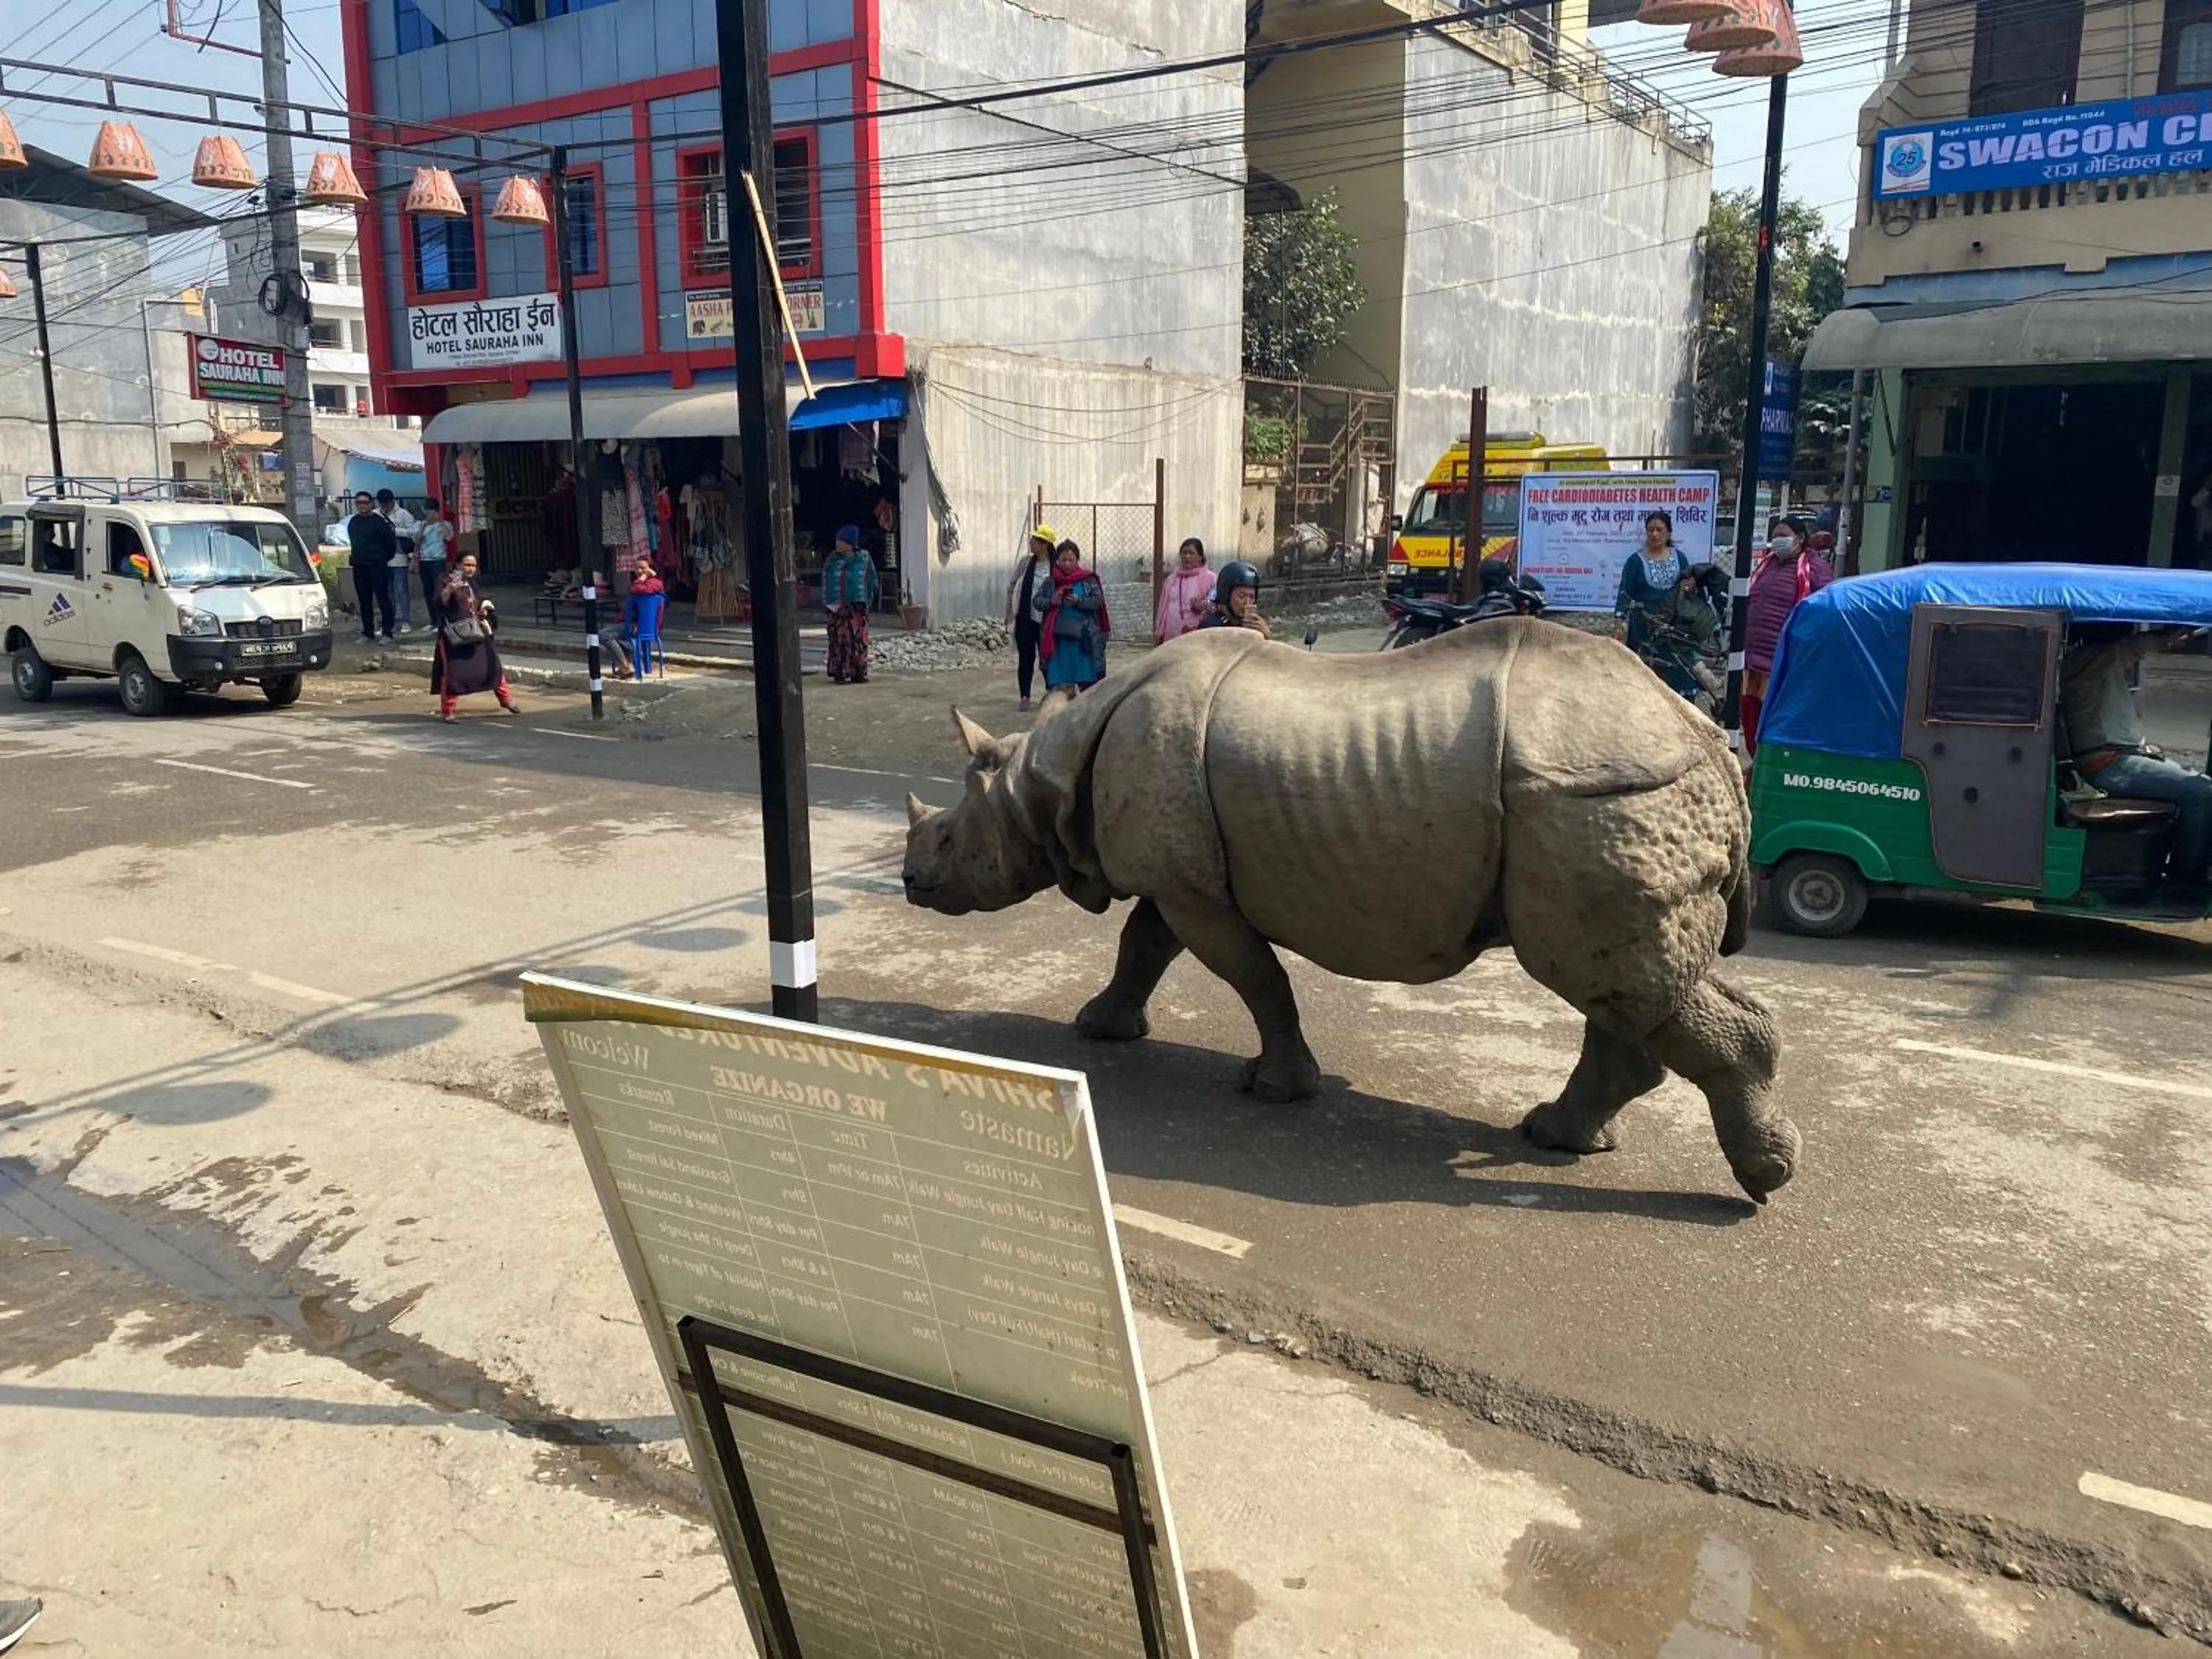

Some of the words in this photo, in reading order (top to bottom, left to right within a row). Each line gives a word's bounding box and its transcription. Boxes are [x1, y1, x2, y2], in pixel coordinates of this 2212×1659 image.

[1938, 120, 2149, 170] SWACON
[1896, 152, 1917, 166] 25
[2042, 162, 2078, 179] राज
[785, 294, 821, 310] ORNER
[411, 308, 457, 340] होटल
[463, 302, 521, 335] सौराहा
[526, 298, 555, 331] ईन
[426, 341, 462, 354] HOTEL
[465, 335, 518, 352] SAURAHA
[523, 333, 543, 347] INN
[218, 347, 279, 369] HOTEL
[199, 362, 261, 383] SAURAHA
[262, 369, 284, 386] INN
[1528, 490, 1549, 504] FREE
[1552, 488, 1637, 503] CARDIODIABETES
[1639, 487, 1676, 503] HEALTH
[1679, 487, 1710, 503] CAMP
[44, 611, 76, 627] adidas
